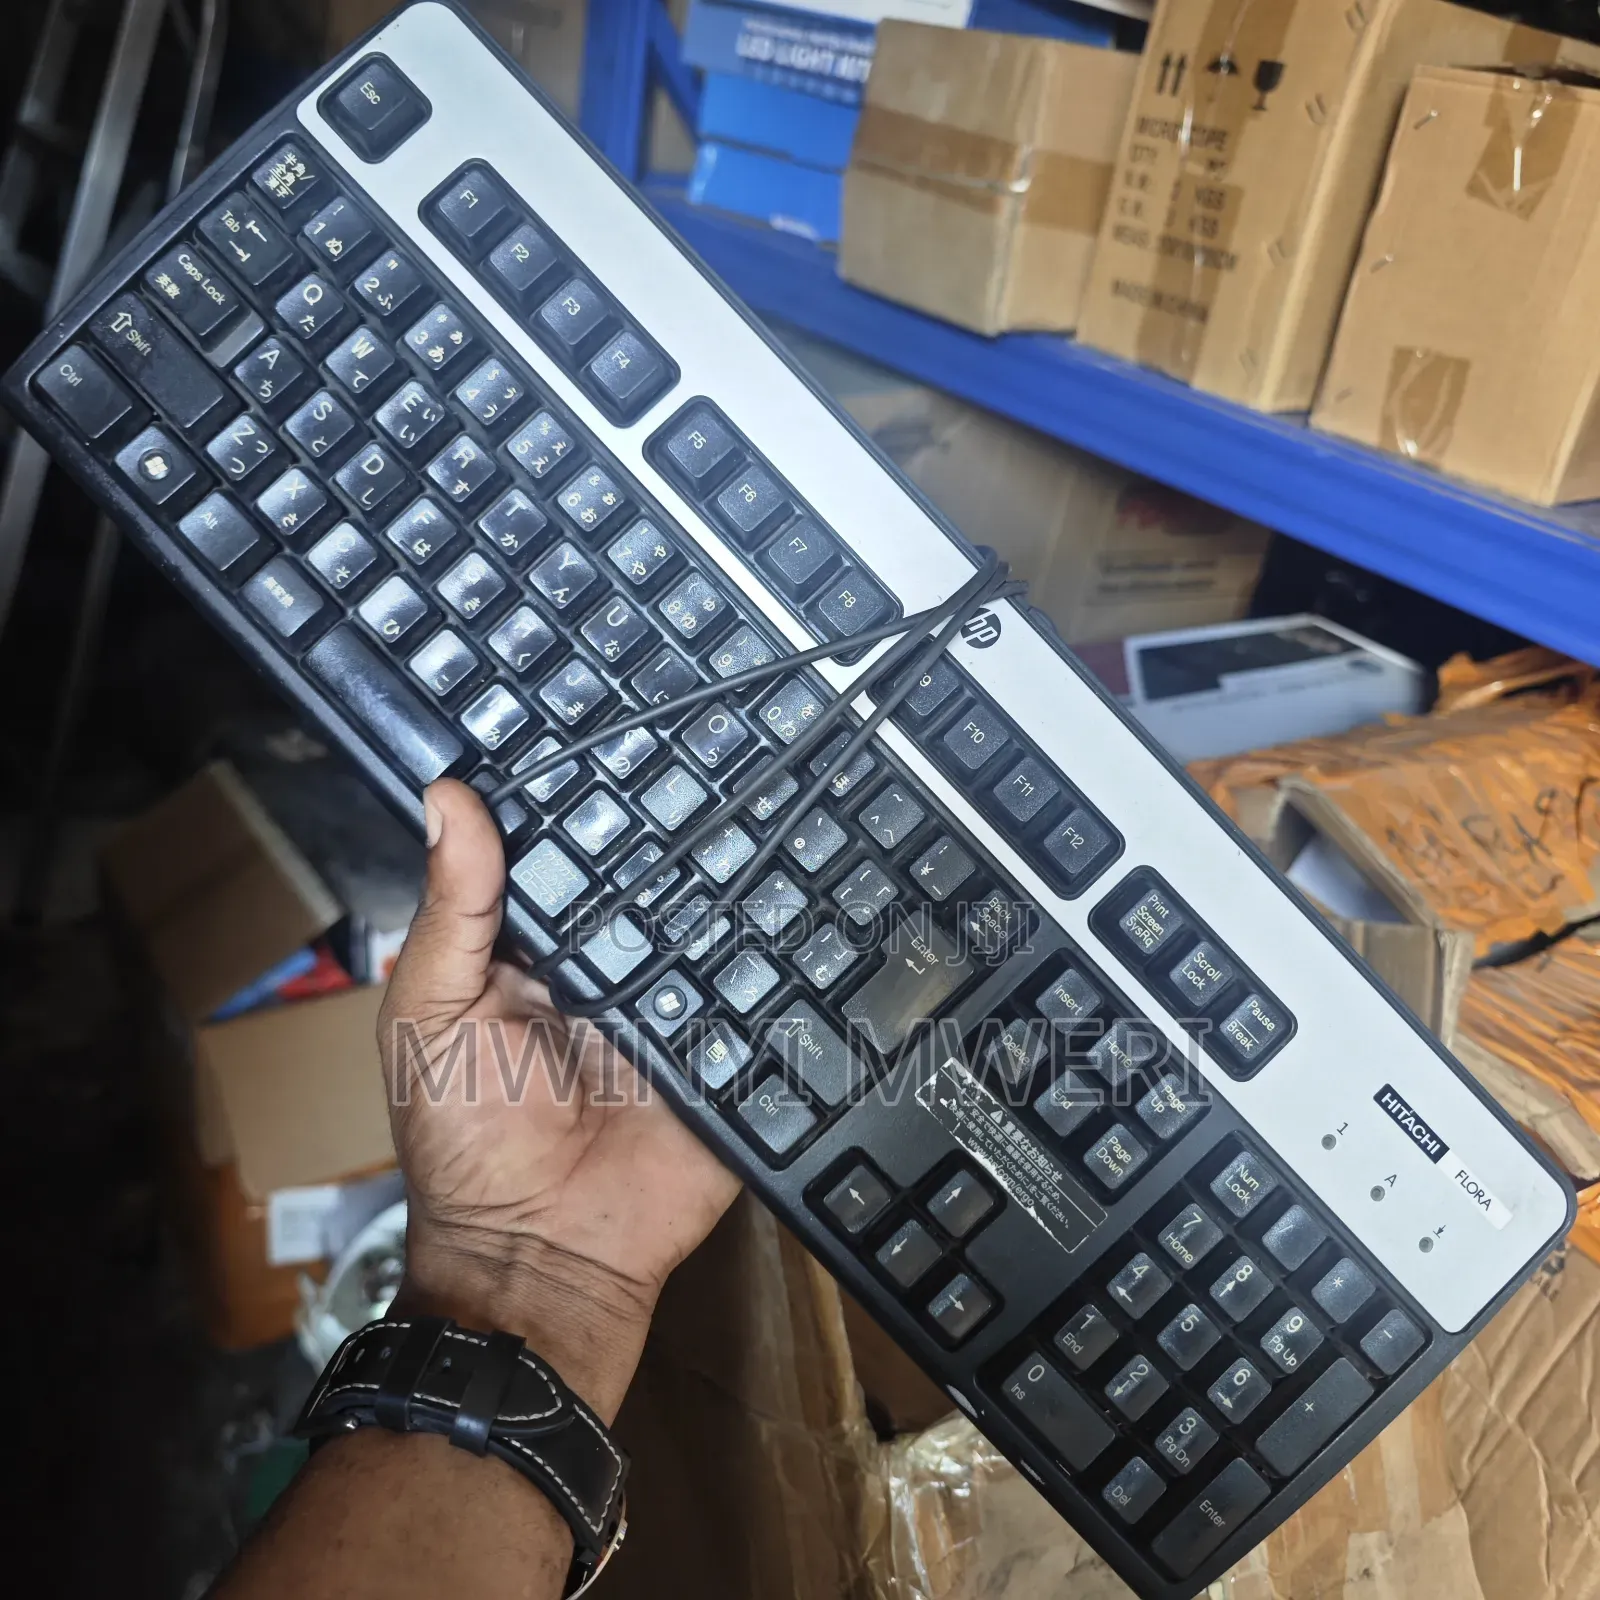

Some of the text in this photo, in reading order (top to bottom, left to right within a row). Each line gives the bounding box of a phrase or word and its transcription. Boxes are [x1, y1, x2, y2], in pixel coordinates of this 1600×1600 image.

[360, 82, 381, 104] Esc
[460, 190, 479, 209] F1
[220, 210, 241, 233] Tab
[313, 221, 327, 235] 1
[510, 242, 530, 263] F2
[155, 273, 181, 300] 英数
[178, 254, 226, 306] Caps Lock
[363, 277, 380, 294] 2
[303, 284, 323, 306] Q
[377, 293, 394, 311] ふ
[562, 297, 581, 316] F3
[298, 315, 316, 333] た
[126, 329, 152, 357] Shift
[351, 336, 375, 359] W
[414, 331, 430, 345] 3
[259, 348, 281, 370] A
[611, 350, 631, 370] F4
[60, 364, 83, 387] Ctrl
[353, 370, 369, 387] て
[259, 379, 274, 398] ち
[466, 389, 481, 400] 4
[313, 400, 333, 421] S
[401, 391, 423, 413] E
[232, 423, 256, 446] Z
[400, 424, 416, 441] い
[688, 430, 708, 450] F5
[311, 436, 328, 453] と
[515, 440, 534, 454] 5
[361, 454, 385, 476] D
[452, 446, 476, 469] R
[284, 477, 307, 500] X
[452, 479, 470, 495] す
[738, 483, 757, 503] F6
[505, 496, 528, 516] T
[568, 491, 582, 507] 6
[200, 511, 219, 530] Alt
[282, 512, 299, 528] さ
[413, 508, 437, 525] F
[500, 533, 519, 549] か
[788, 536, 808, 554] F7
[558, 552, 578, 571] Y
[617, 547, 632, 560] 7
[334, 566, 351, 583] そ
[552, 587, 570, 604] ん
[838, 590, 857, 609] F8
[606, 605, 629, 627] U
[667, 600, 682, 614] 8
[382, 619, 401, 636] ひ
[962, 611, 999, 646] hp
[603, 639, 621, 657] な
[517, 652, 531, 667] く
[717, 653, 733, 667] 9
[565, 672, 587, 687] J
[708, 714, 729, 734] O
[963, 721, 985, 744] F10
[707, 746, 721, 762] ら
[1013, 774, 1035, 797] F11
[1061, 827, 1085, 850] F12
[988, 896, 1012, 923] Back
[1147, 894, 1170, 919] Print
[978, 907, 1008, 939] Space
[1136, 905, 1164, 936] Screen
[1126, 916, 1154, 949] SysRq
[911, 936, 939, 965] Enter
[1181, 963, 1206, 990] Lock
[1193, 951, 1222, 982] Scroll
[1054, 985, 1083, 1016] Insert
[1247, 999, 1275, 1031] Pause
[1227, 1021, 1254, 1051] Break
[799, 1034, 824, 1060] Shift
[1002, 1034, 1030, 1065] Delete
[1104, 1036, 1132, 1068] Home
[758, 1093, 780, 1116] Ctrl
[1053, 1087, 1074, 1110] End
[1150, 1097, 1165, 1113] Up
[1161, 1085, 1186, 1113] Page
[1336, 1121, 1349, 1136] 1
[1380, 1092, 1441, 1155] HITACHI
[1000, 1119, 1065, 1184] 重要なお知らせ
[1107, 1136, 1132, 1164] Page
[1096, 1147, 1124, 1177] Down
[1237, 1165, 1259, 1190] Num
[1384, 1173, 1397, 1188] A
[1224, 1176, 1251, 1204] Lock
[1454, 1169, 1492, 1212] FLORA
[1182, 1212, 1203, 1228] 7
[1165, 1232, 1194, 1263] Home
[1132, 1264, 1150, 1280] 4
[1236, 1265, 1253, 1282] 8
[1080, 1314, 1095, 1330] 1
[1181, 1314, 1199, 1332] 5
[1286, 1316, 1303, 1333] 9
[1062, 1332, 1084, 1355] End
[1268, 1335, 1298, 1367] Pg Up
[1027, 1364, 1045, 1383] 0
[1130, 1364, 1150, 1382] 2
[1233, 1368, 1251, 1386] 6
[1010, 1382, 1026, 1401] Ins
[1179, 1417, 1197, 1435] 3
[1163, 1436, 1191, 1468] Pg Dn
[1111, 1486, 1131, 1506] Del
[1199, 1499, 1226, 1528] Enter
